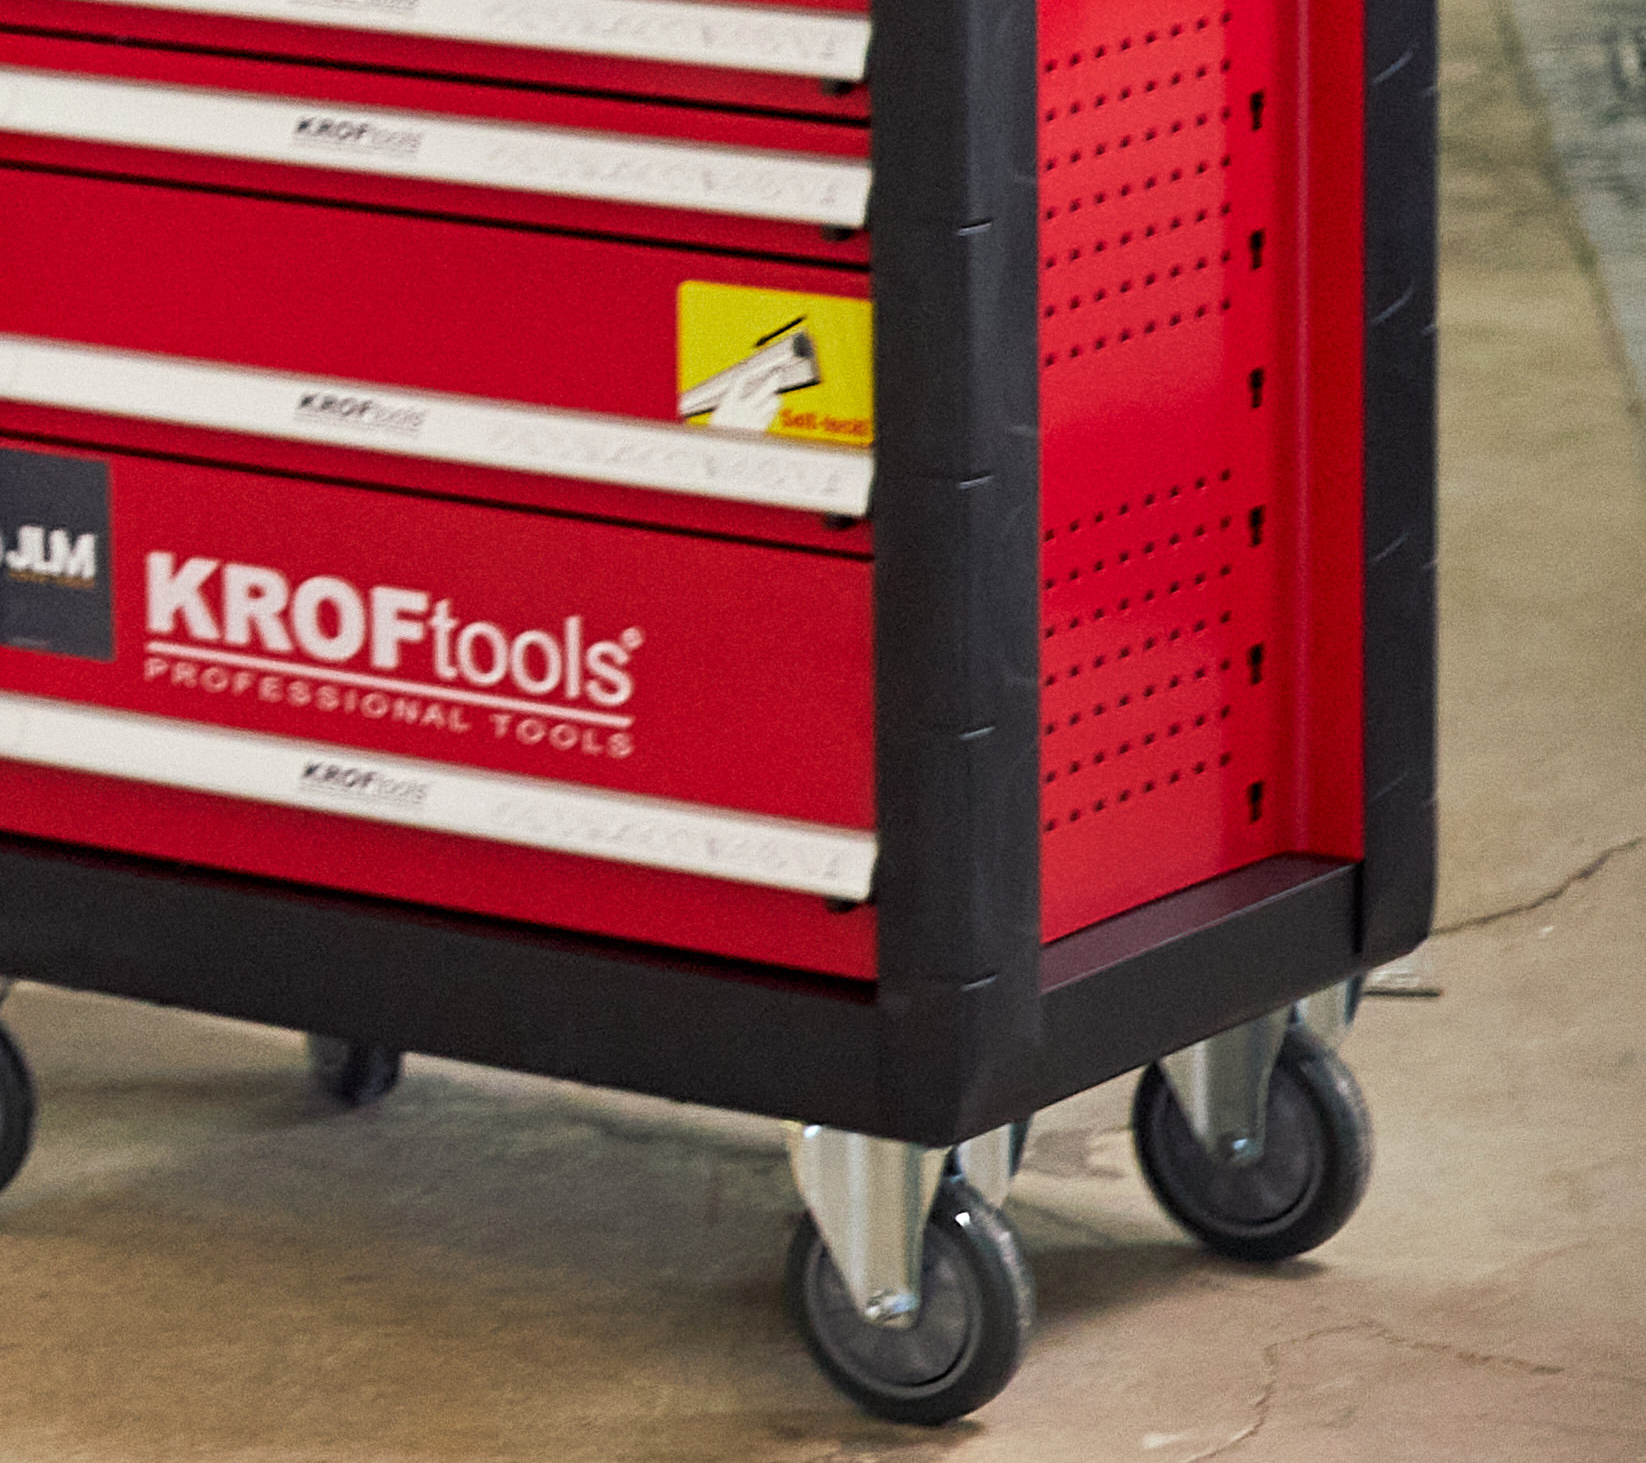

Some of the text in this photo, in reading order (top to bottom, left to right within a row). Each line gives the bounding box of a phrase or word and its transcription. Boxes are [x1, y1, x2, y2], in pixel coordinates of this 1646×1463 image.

[5, 525, 98, 579] JLM
[144, 657, 635, 760] PROFESSIONAL TOOLS
